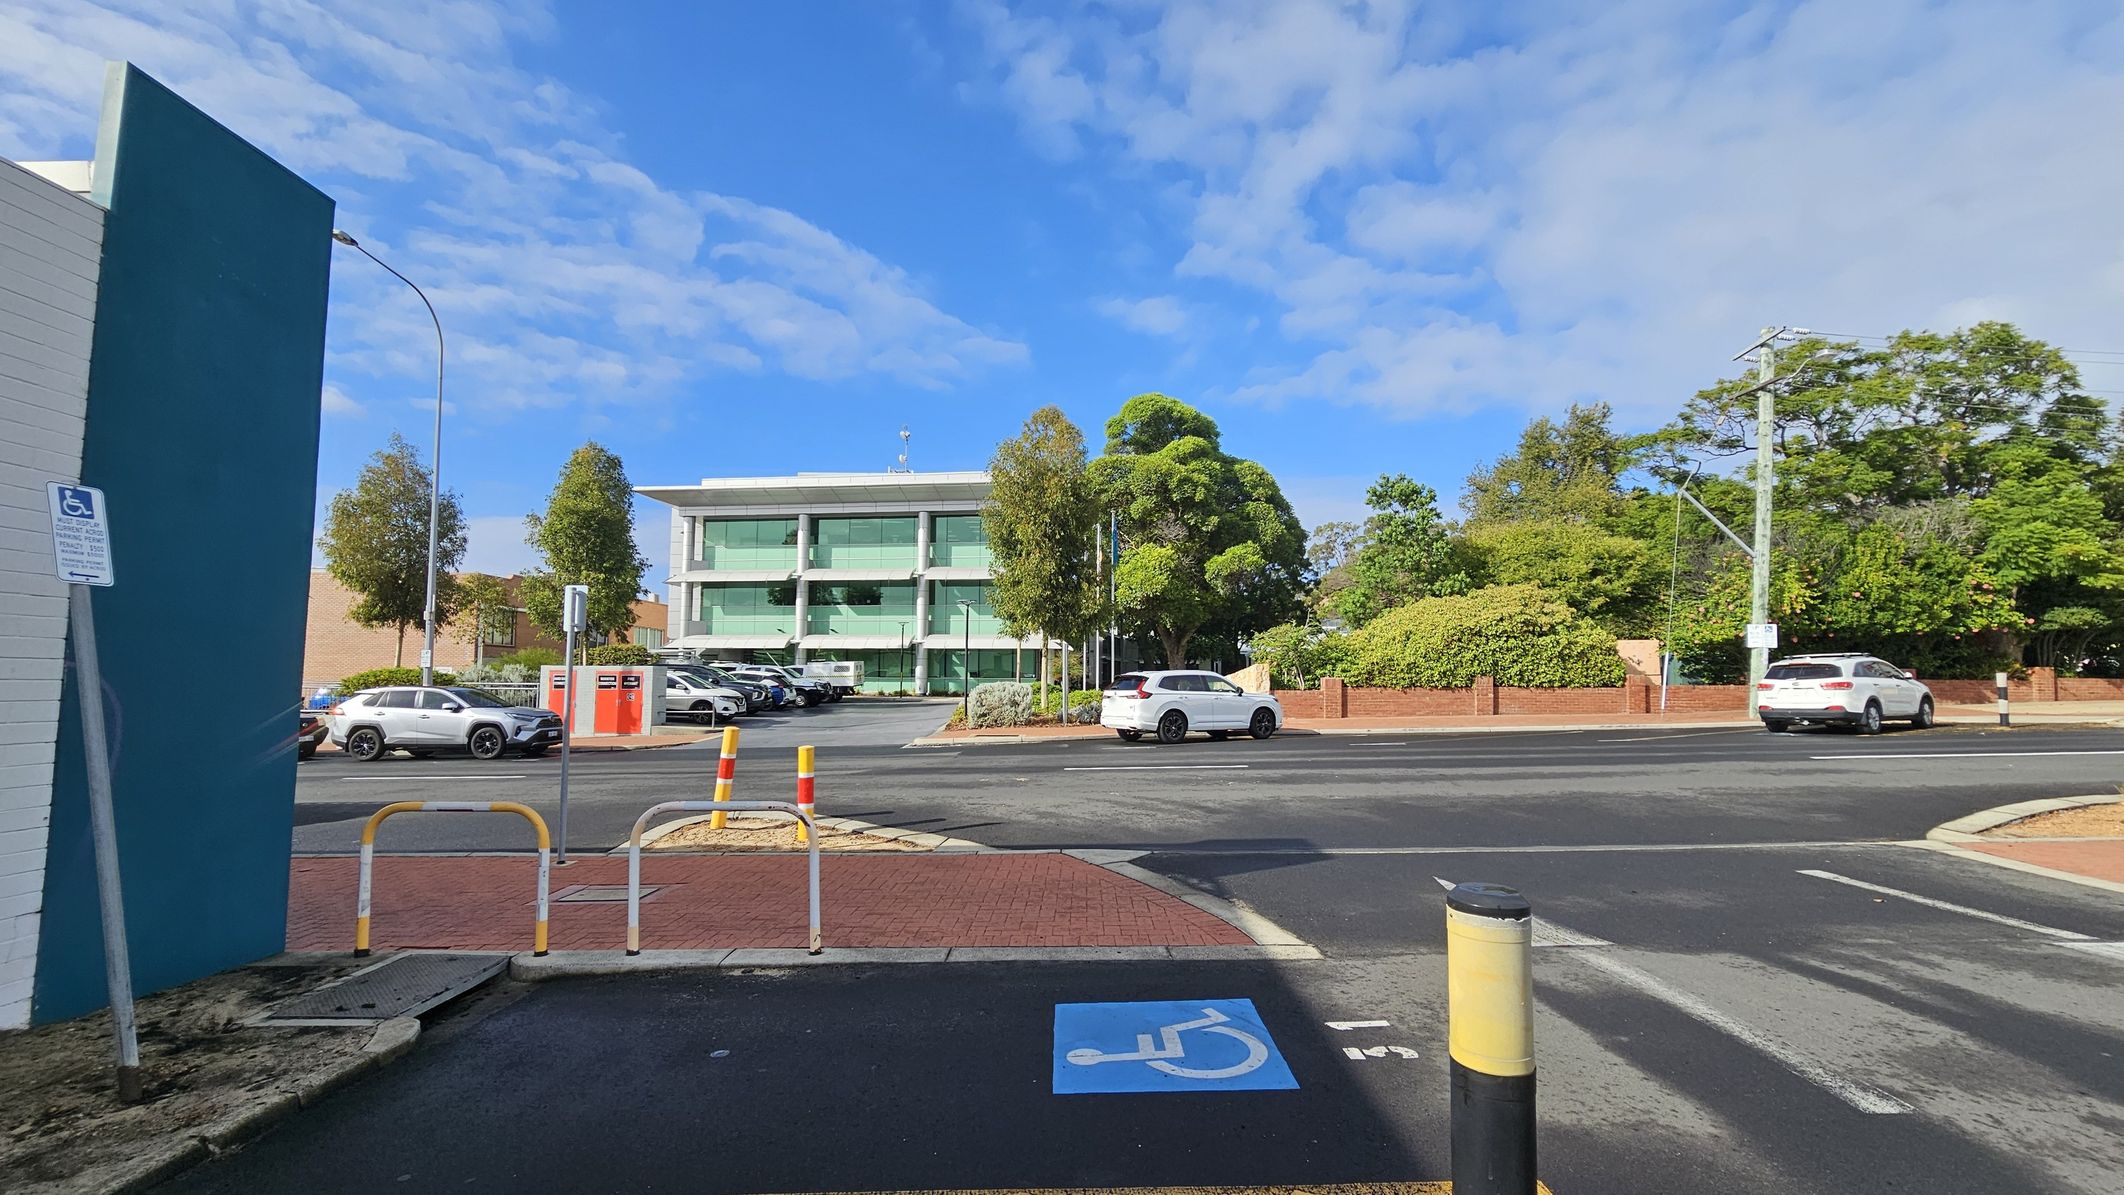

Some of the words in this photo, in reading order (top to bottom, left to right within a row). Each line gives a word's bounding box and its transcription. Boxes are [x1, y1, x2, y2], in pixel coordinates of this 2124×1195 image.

[55, 523, 83, 534] CURRENT
[55, 531, 82, 541] PARKING
[84, 535, 105, 544] PERMIT
